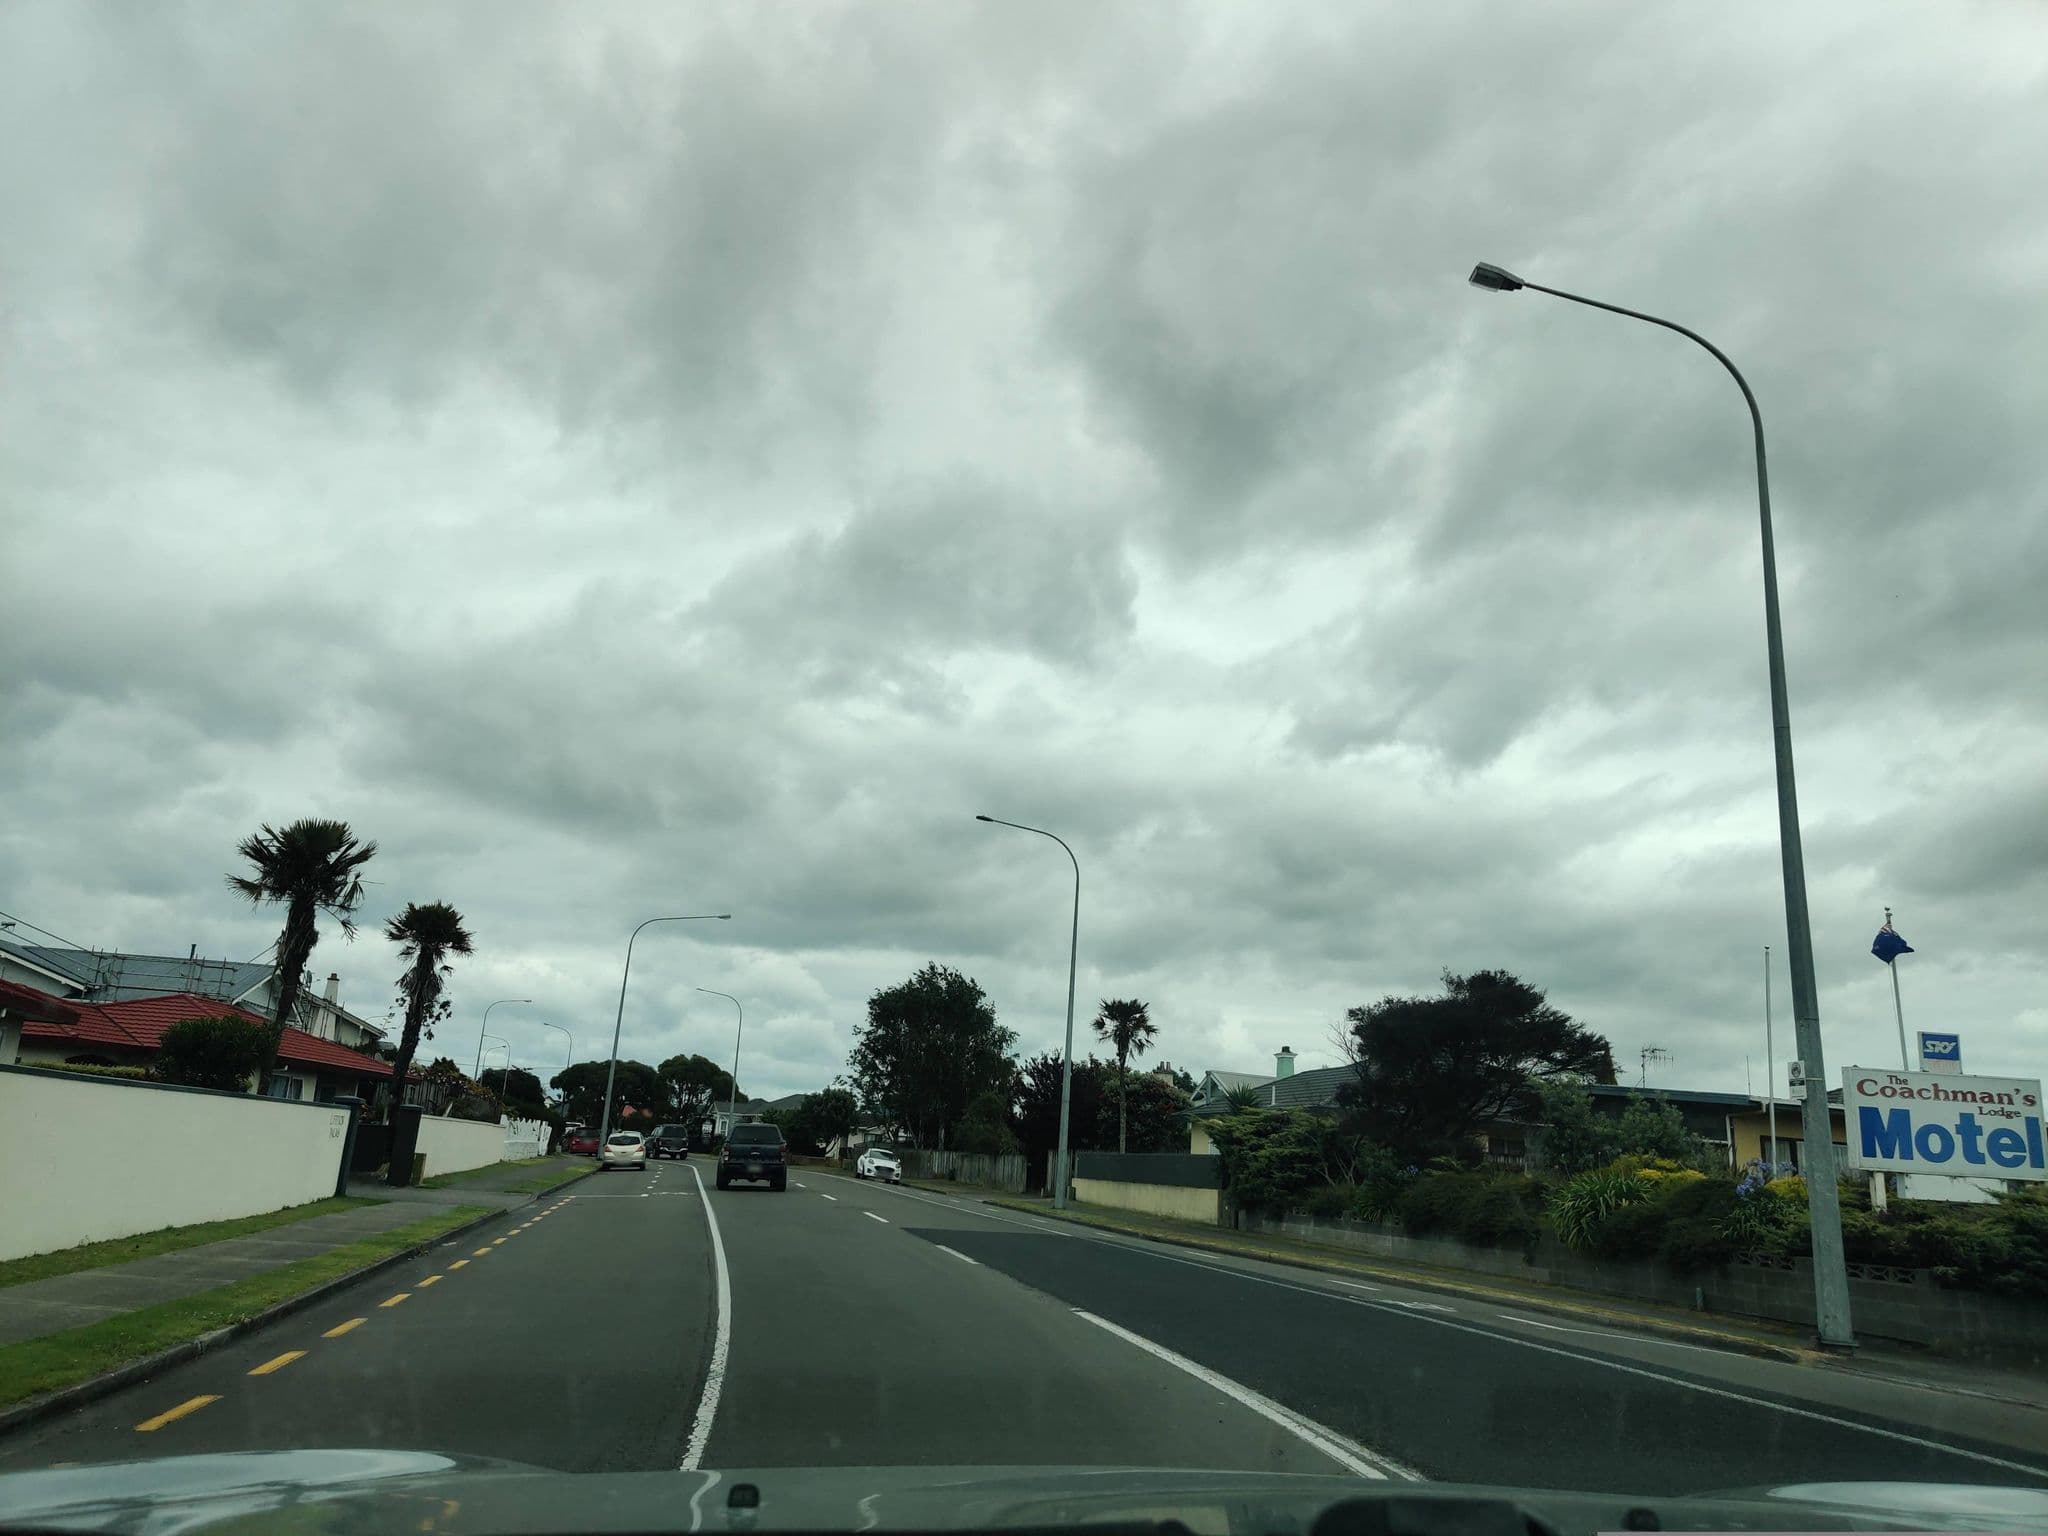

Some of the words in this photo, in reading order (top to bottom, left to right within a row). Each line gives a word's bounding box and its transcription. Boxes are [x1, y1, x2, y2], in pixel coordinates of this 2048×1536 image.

[1887, 1075, 1909, 1086] The
[1856, 1078, 2038, 1107] Coachman's
[1978, 1106, 2022, 1120] Lodge
[1858, 1106, 2045, 1169] Motel
